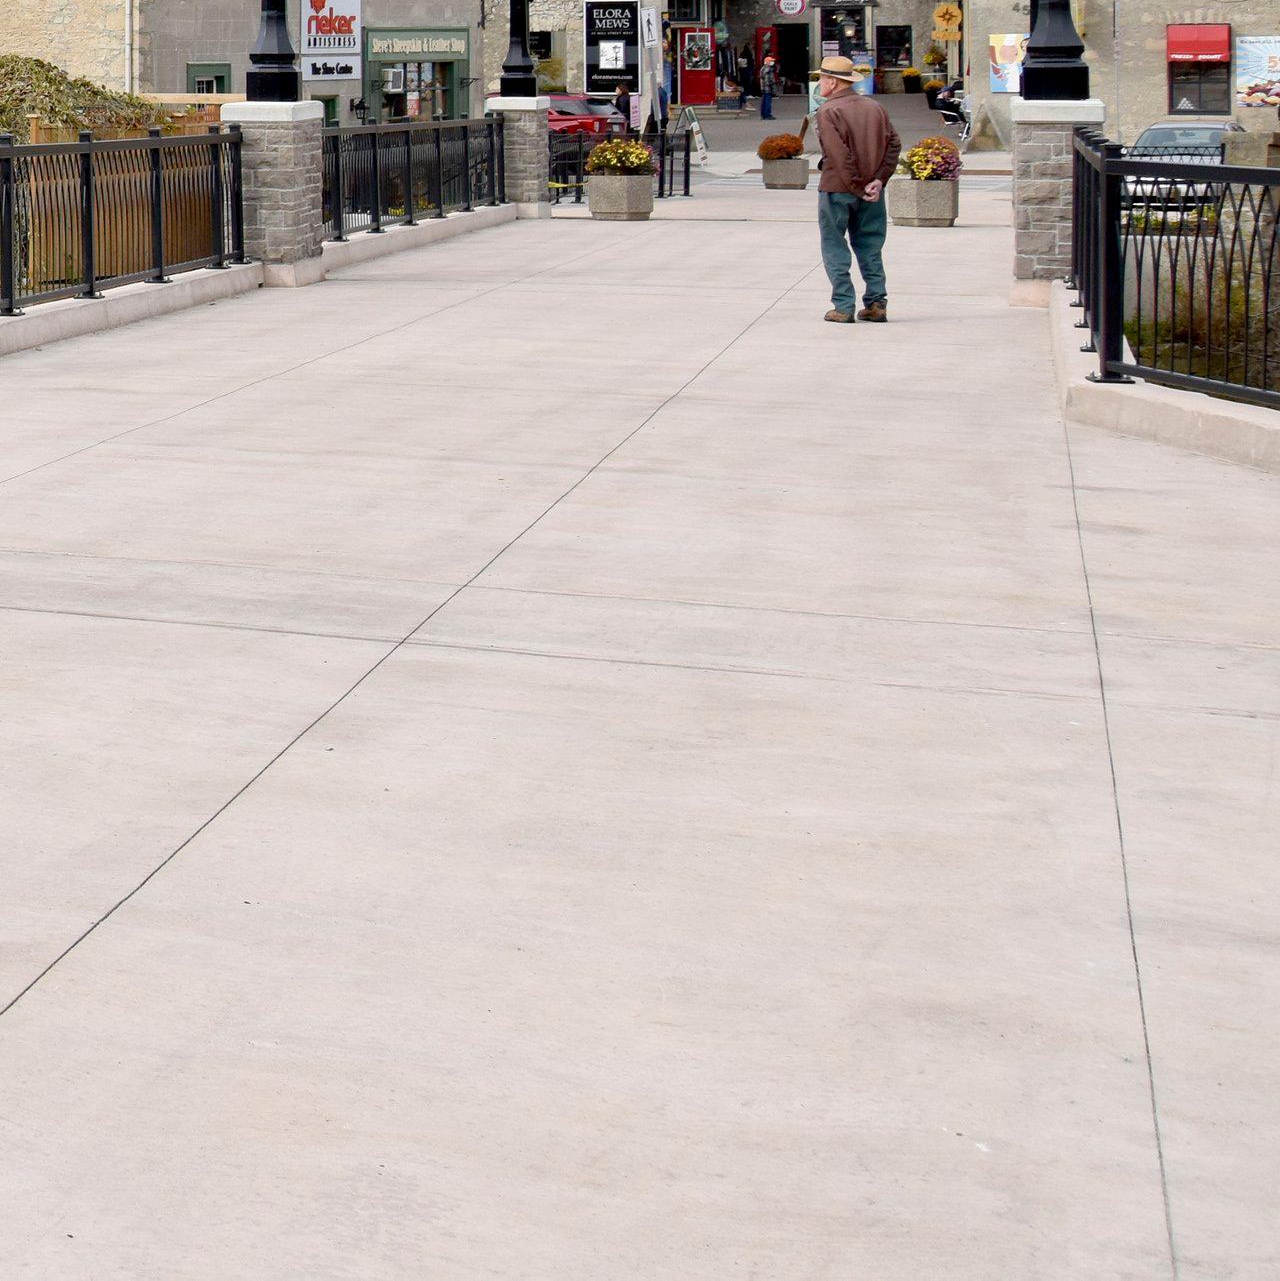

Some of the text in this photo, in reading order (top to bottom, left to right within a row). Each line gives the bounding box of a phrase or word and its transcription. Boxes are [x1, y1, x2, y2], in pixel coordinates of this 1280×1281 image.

[593, 9, 631, 18] ELORA
[595, 19, 630, 28] MEWS
[311, 62, 321, 75] The
